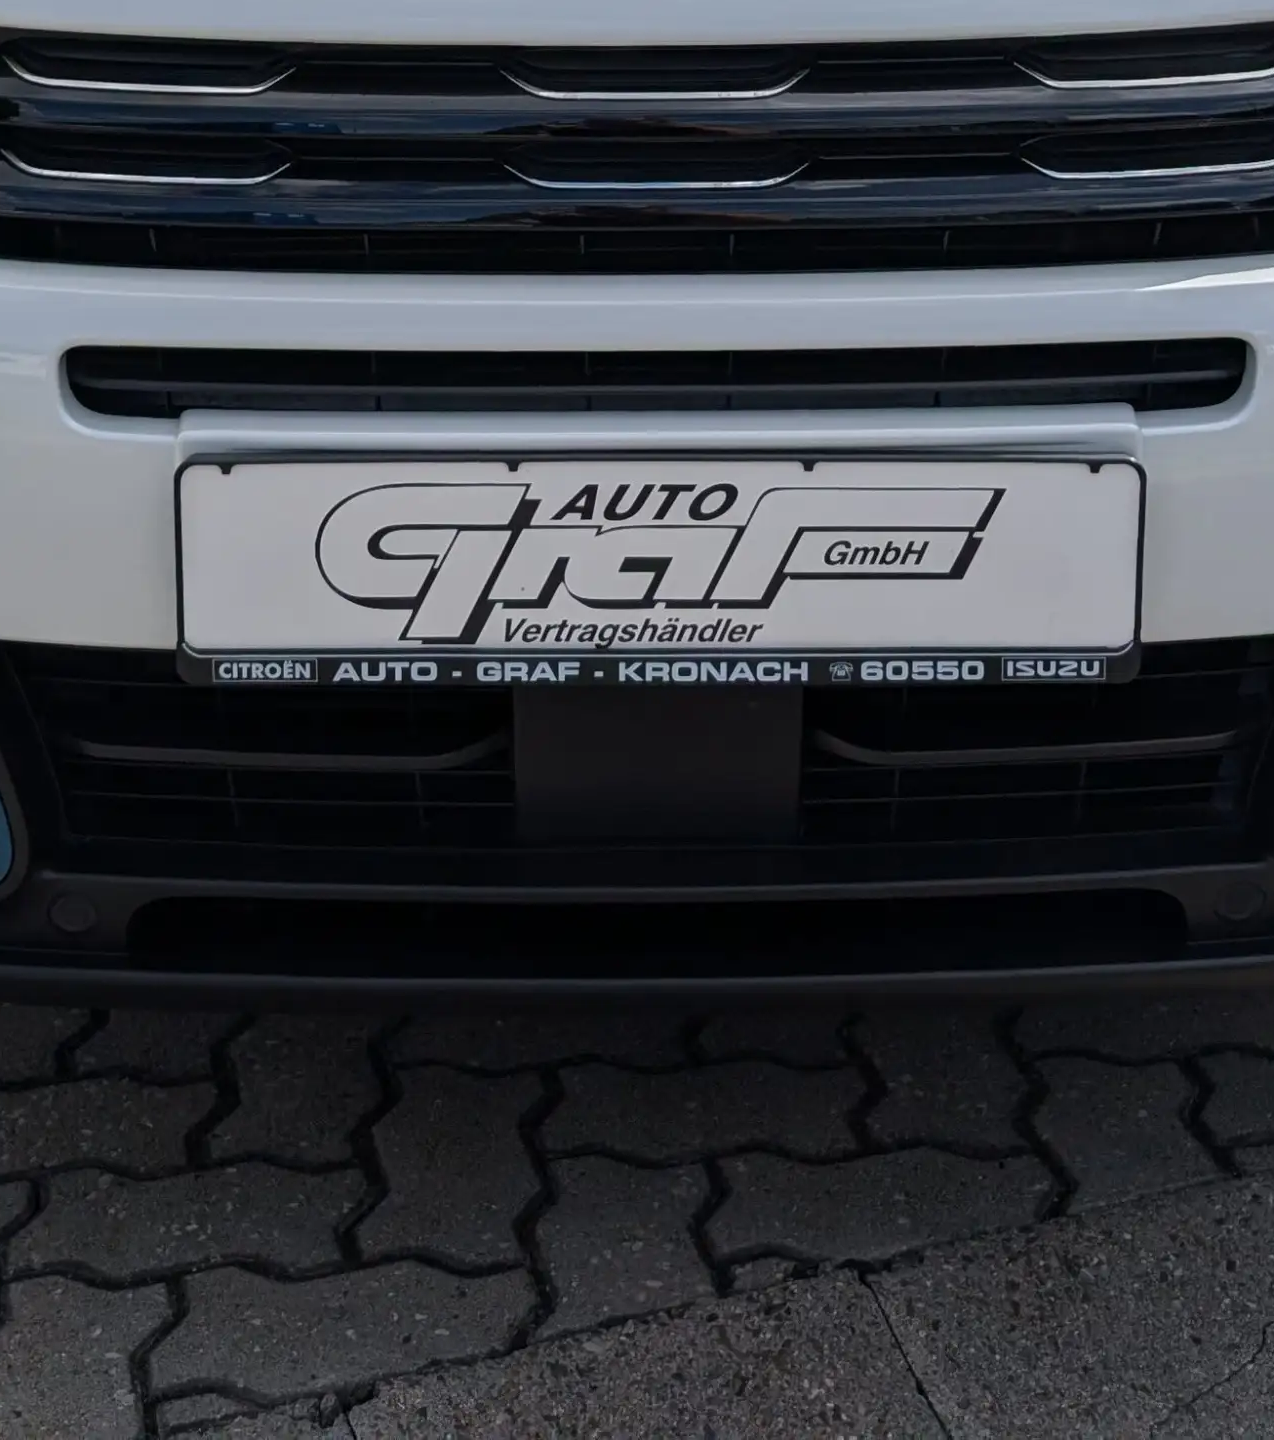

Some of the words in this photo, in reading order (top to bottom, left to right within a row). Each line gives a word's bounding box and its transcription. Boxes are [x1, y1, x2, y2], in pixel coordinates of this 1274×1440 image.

[550, 483, 739, 522] AUTO
[823, 539, 930, 566] GmbH
[503, 617, 764, 649] Vertragshändler
[218, 660, 312, 680] CITROËN
[332, 661, 439, 682] AUTO
[475, 661, 581, 682] GRAF
[618, 661, 810, 682] KRONACH
[859, 660, 986, 681] 60550
[1005, 659, 1101, 677] ISUZU
